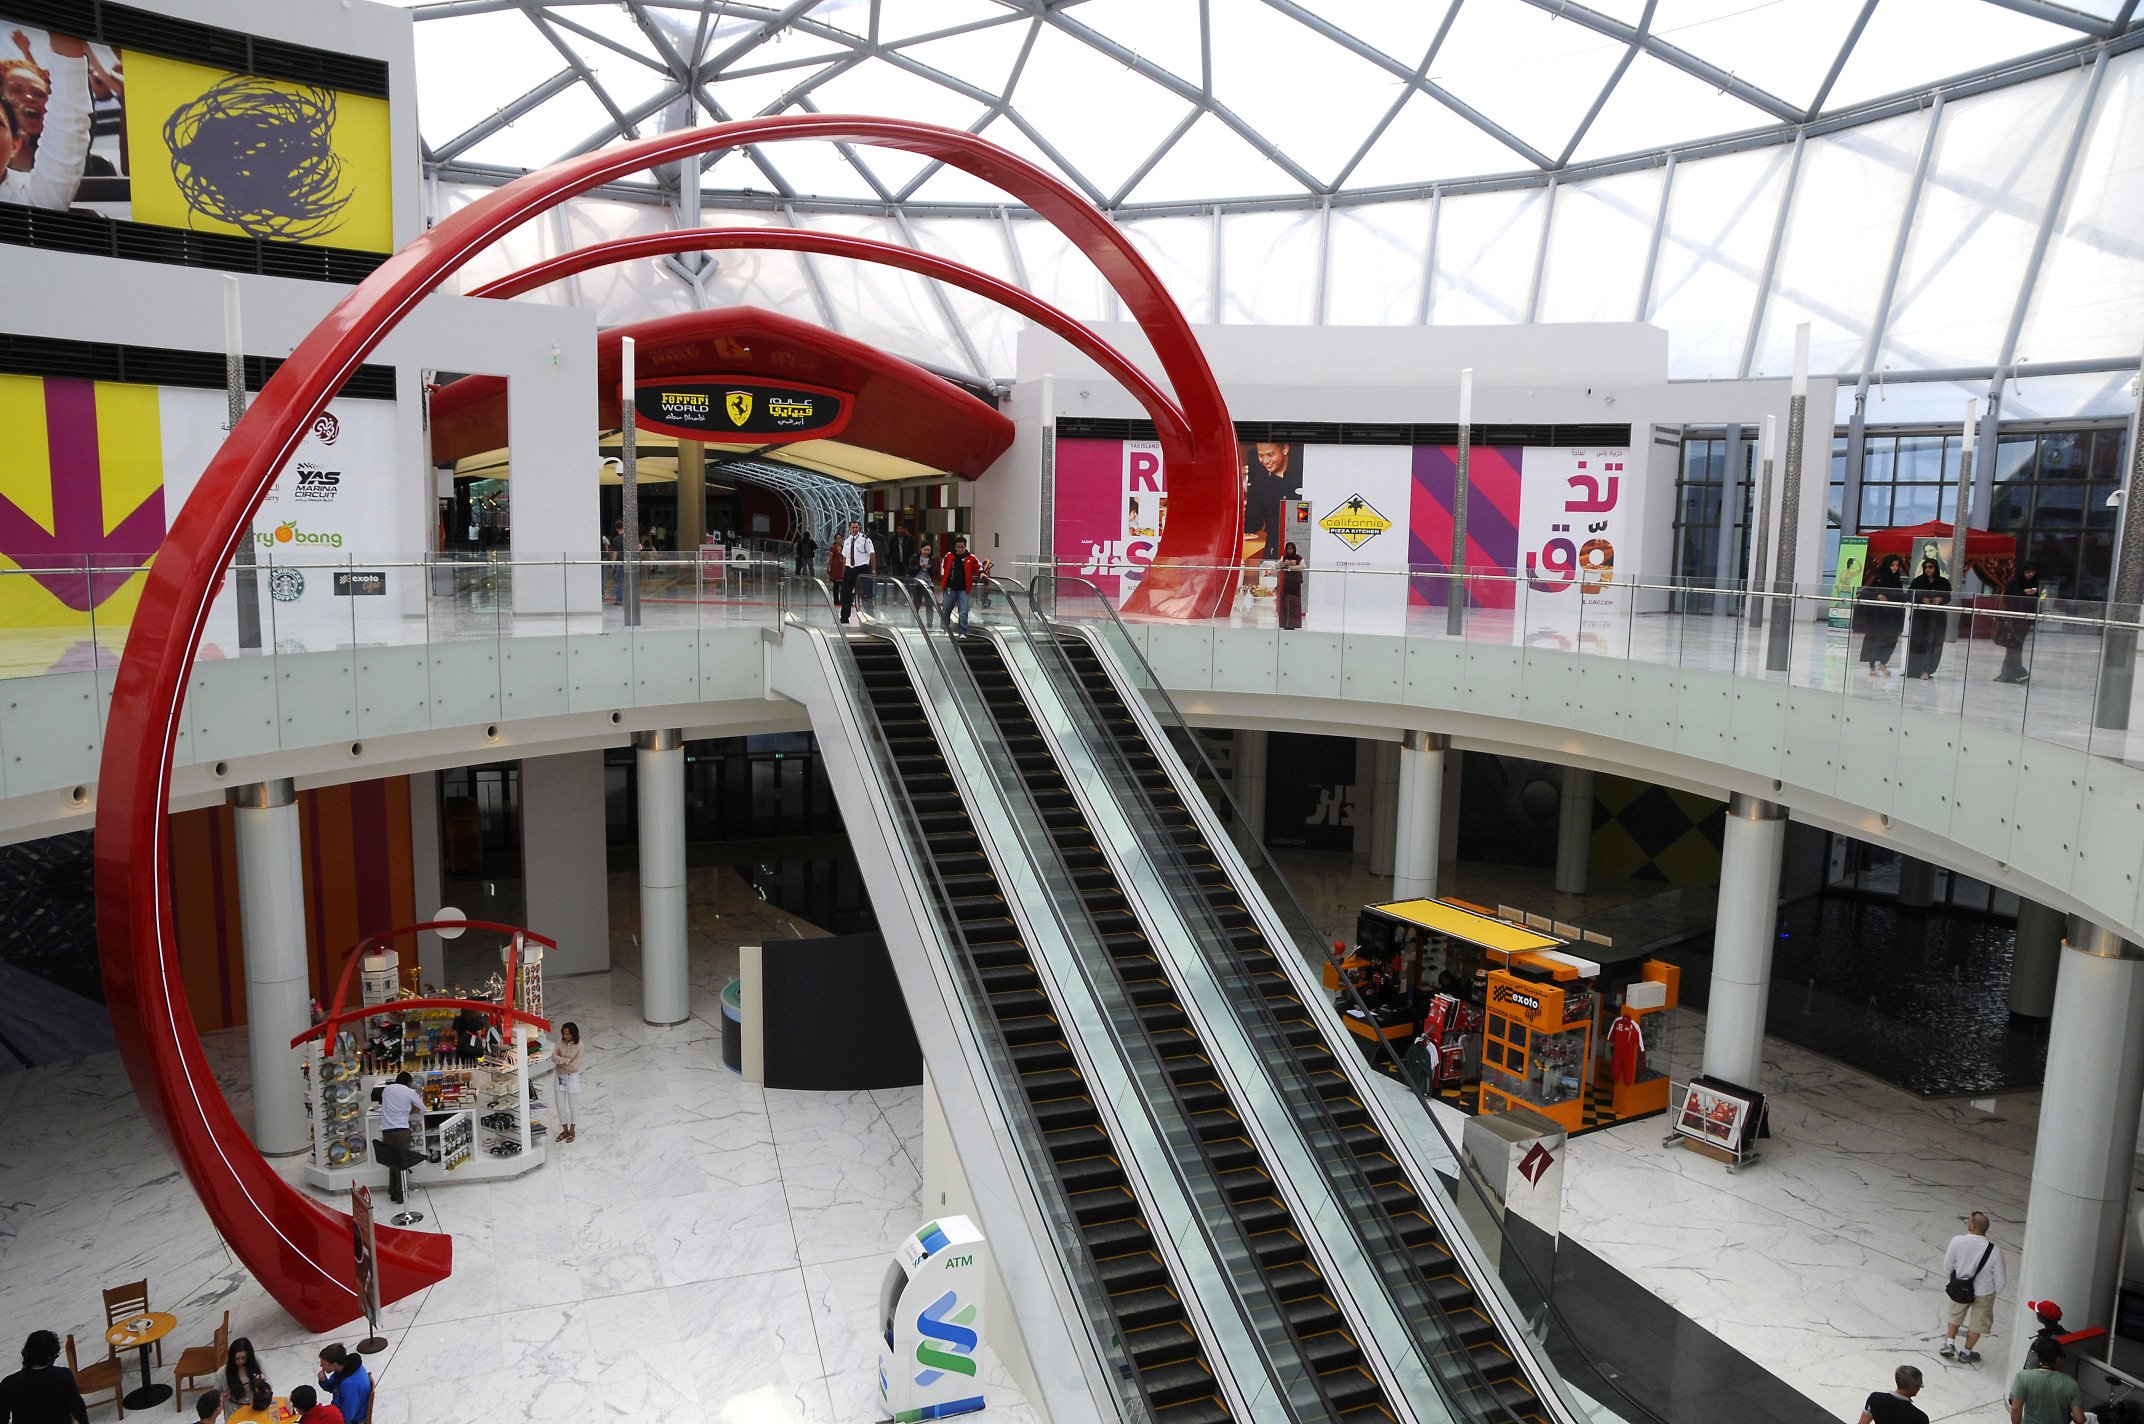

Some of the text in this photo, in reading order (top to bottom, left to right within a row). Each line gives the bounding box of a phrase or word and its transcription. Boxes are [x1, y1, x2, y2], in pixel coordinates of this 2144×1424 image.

[662, 393, 709, 405] Ferrari
[662, 404, 709, 412] WORLD
[296, 470, 341, 485] YAS
[1326, 518, 1384, 528] california
[352, 574, 379, 583] exoto
[1512, 993, 1538, 1009] exoto
[945, 1255, 973, 1269] ATM
